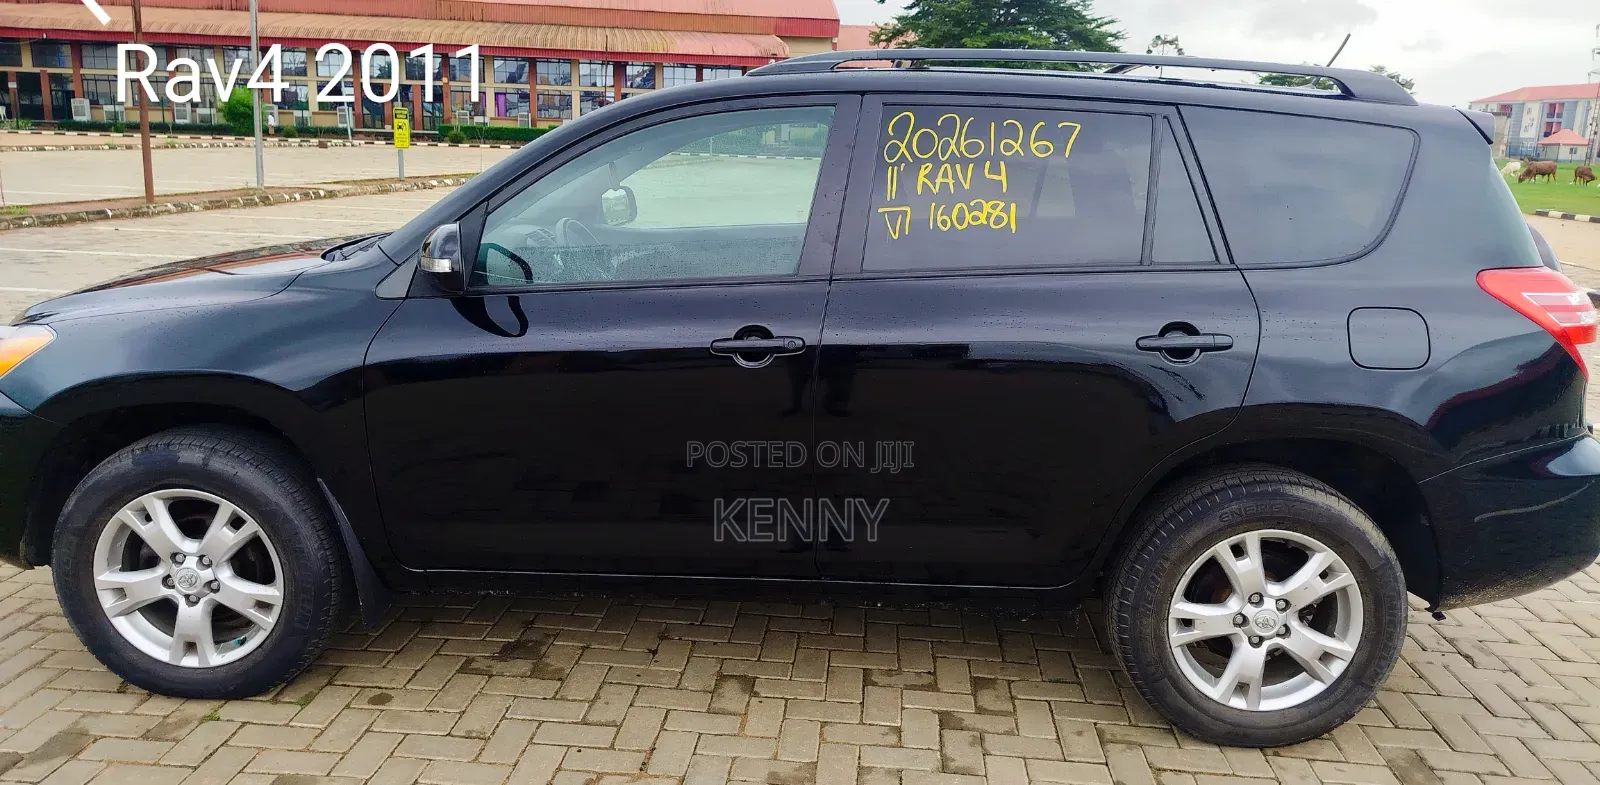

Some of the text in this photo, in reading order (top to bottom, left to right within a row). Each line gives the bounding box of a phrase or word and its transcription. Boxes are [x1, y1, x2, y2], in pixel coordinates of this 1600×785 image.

[883, 111, 1081, 162] 20261267
[917, 163, 974, 195] RAV
[984, 160, 1007, 193] 4
[929, 198, 1016, 233] 160281
